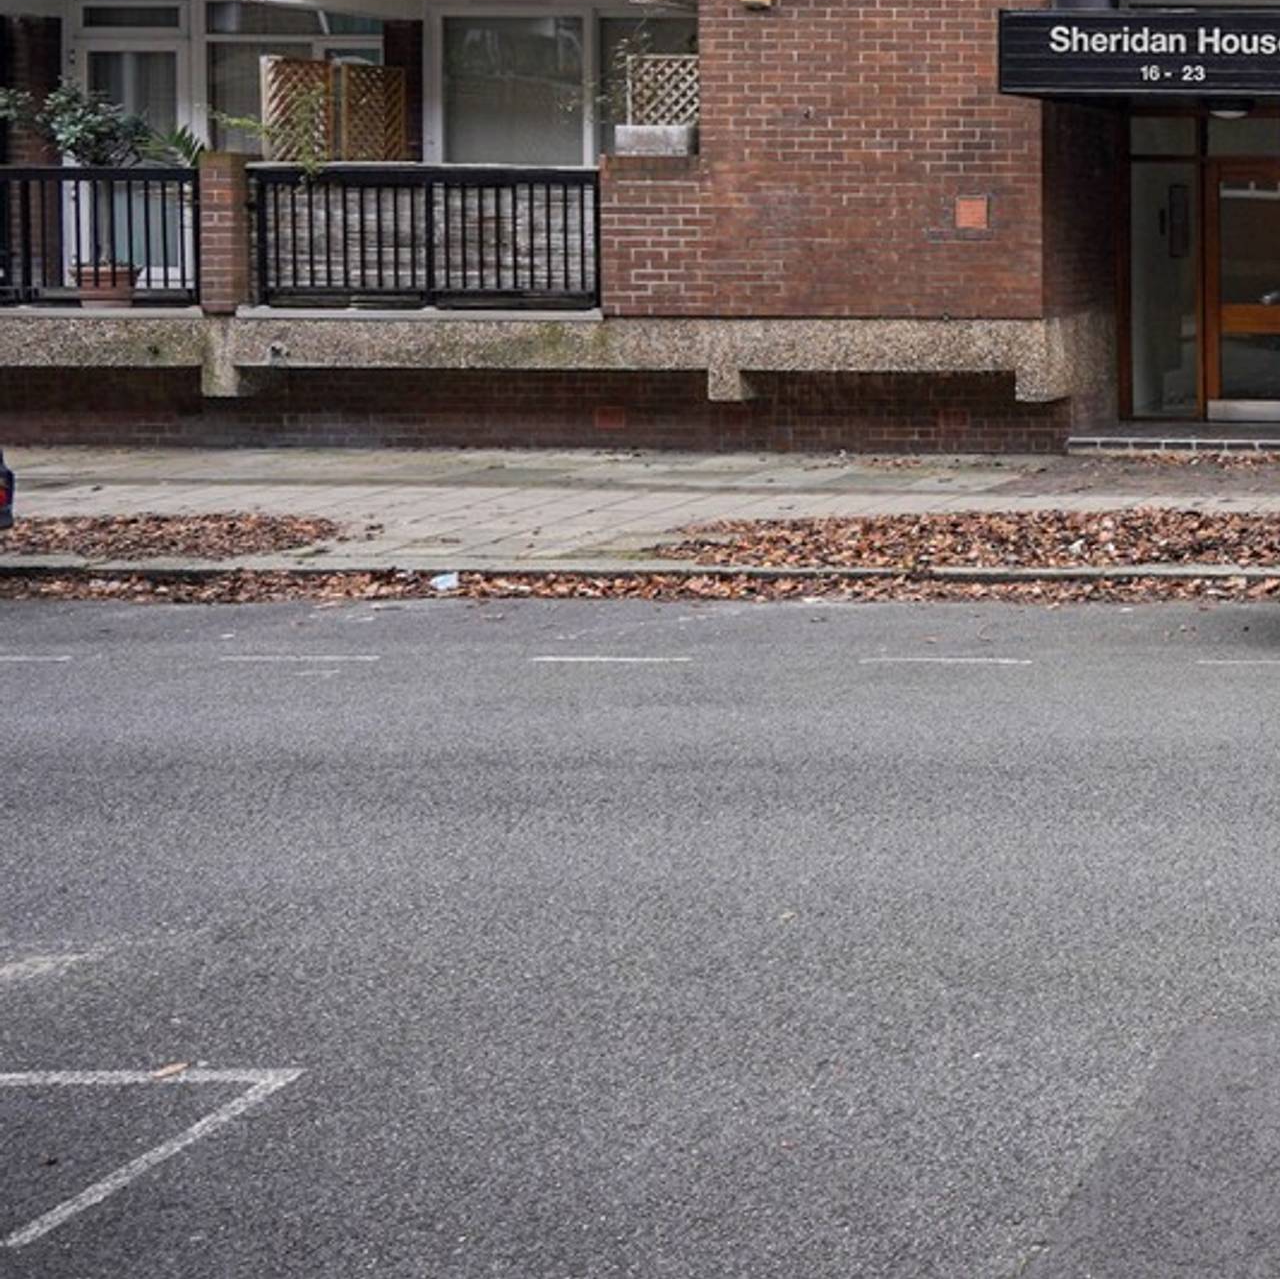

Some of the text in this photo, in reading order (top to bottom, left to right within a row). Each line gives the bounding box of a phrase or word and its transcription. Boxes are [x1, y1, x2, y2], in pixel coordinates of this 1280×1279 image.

[1049, 25, 1187, 53] Sheridan
[1140, 65, 1160, 81] 16
[1181, 65, 1206, 81] 23
